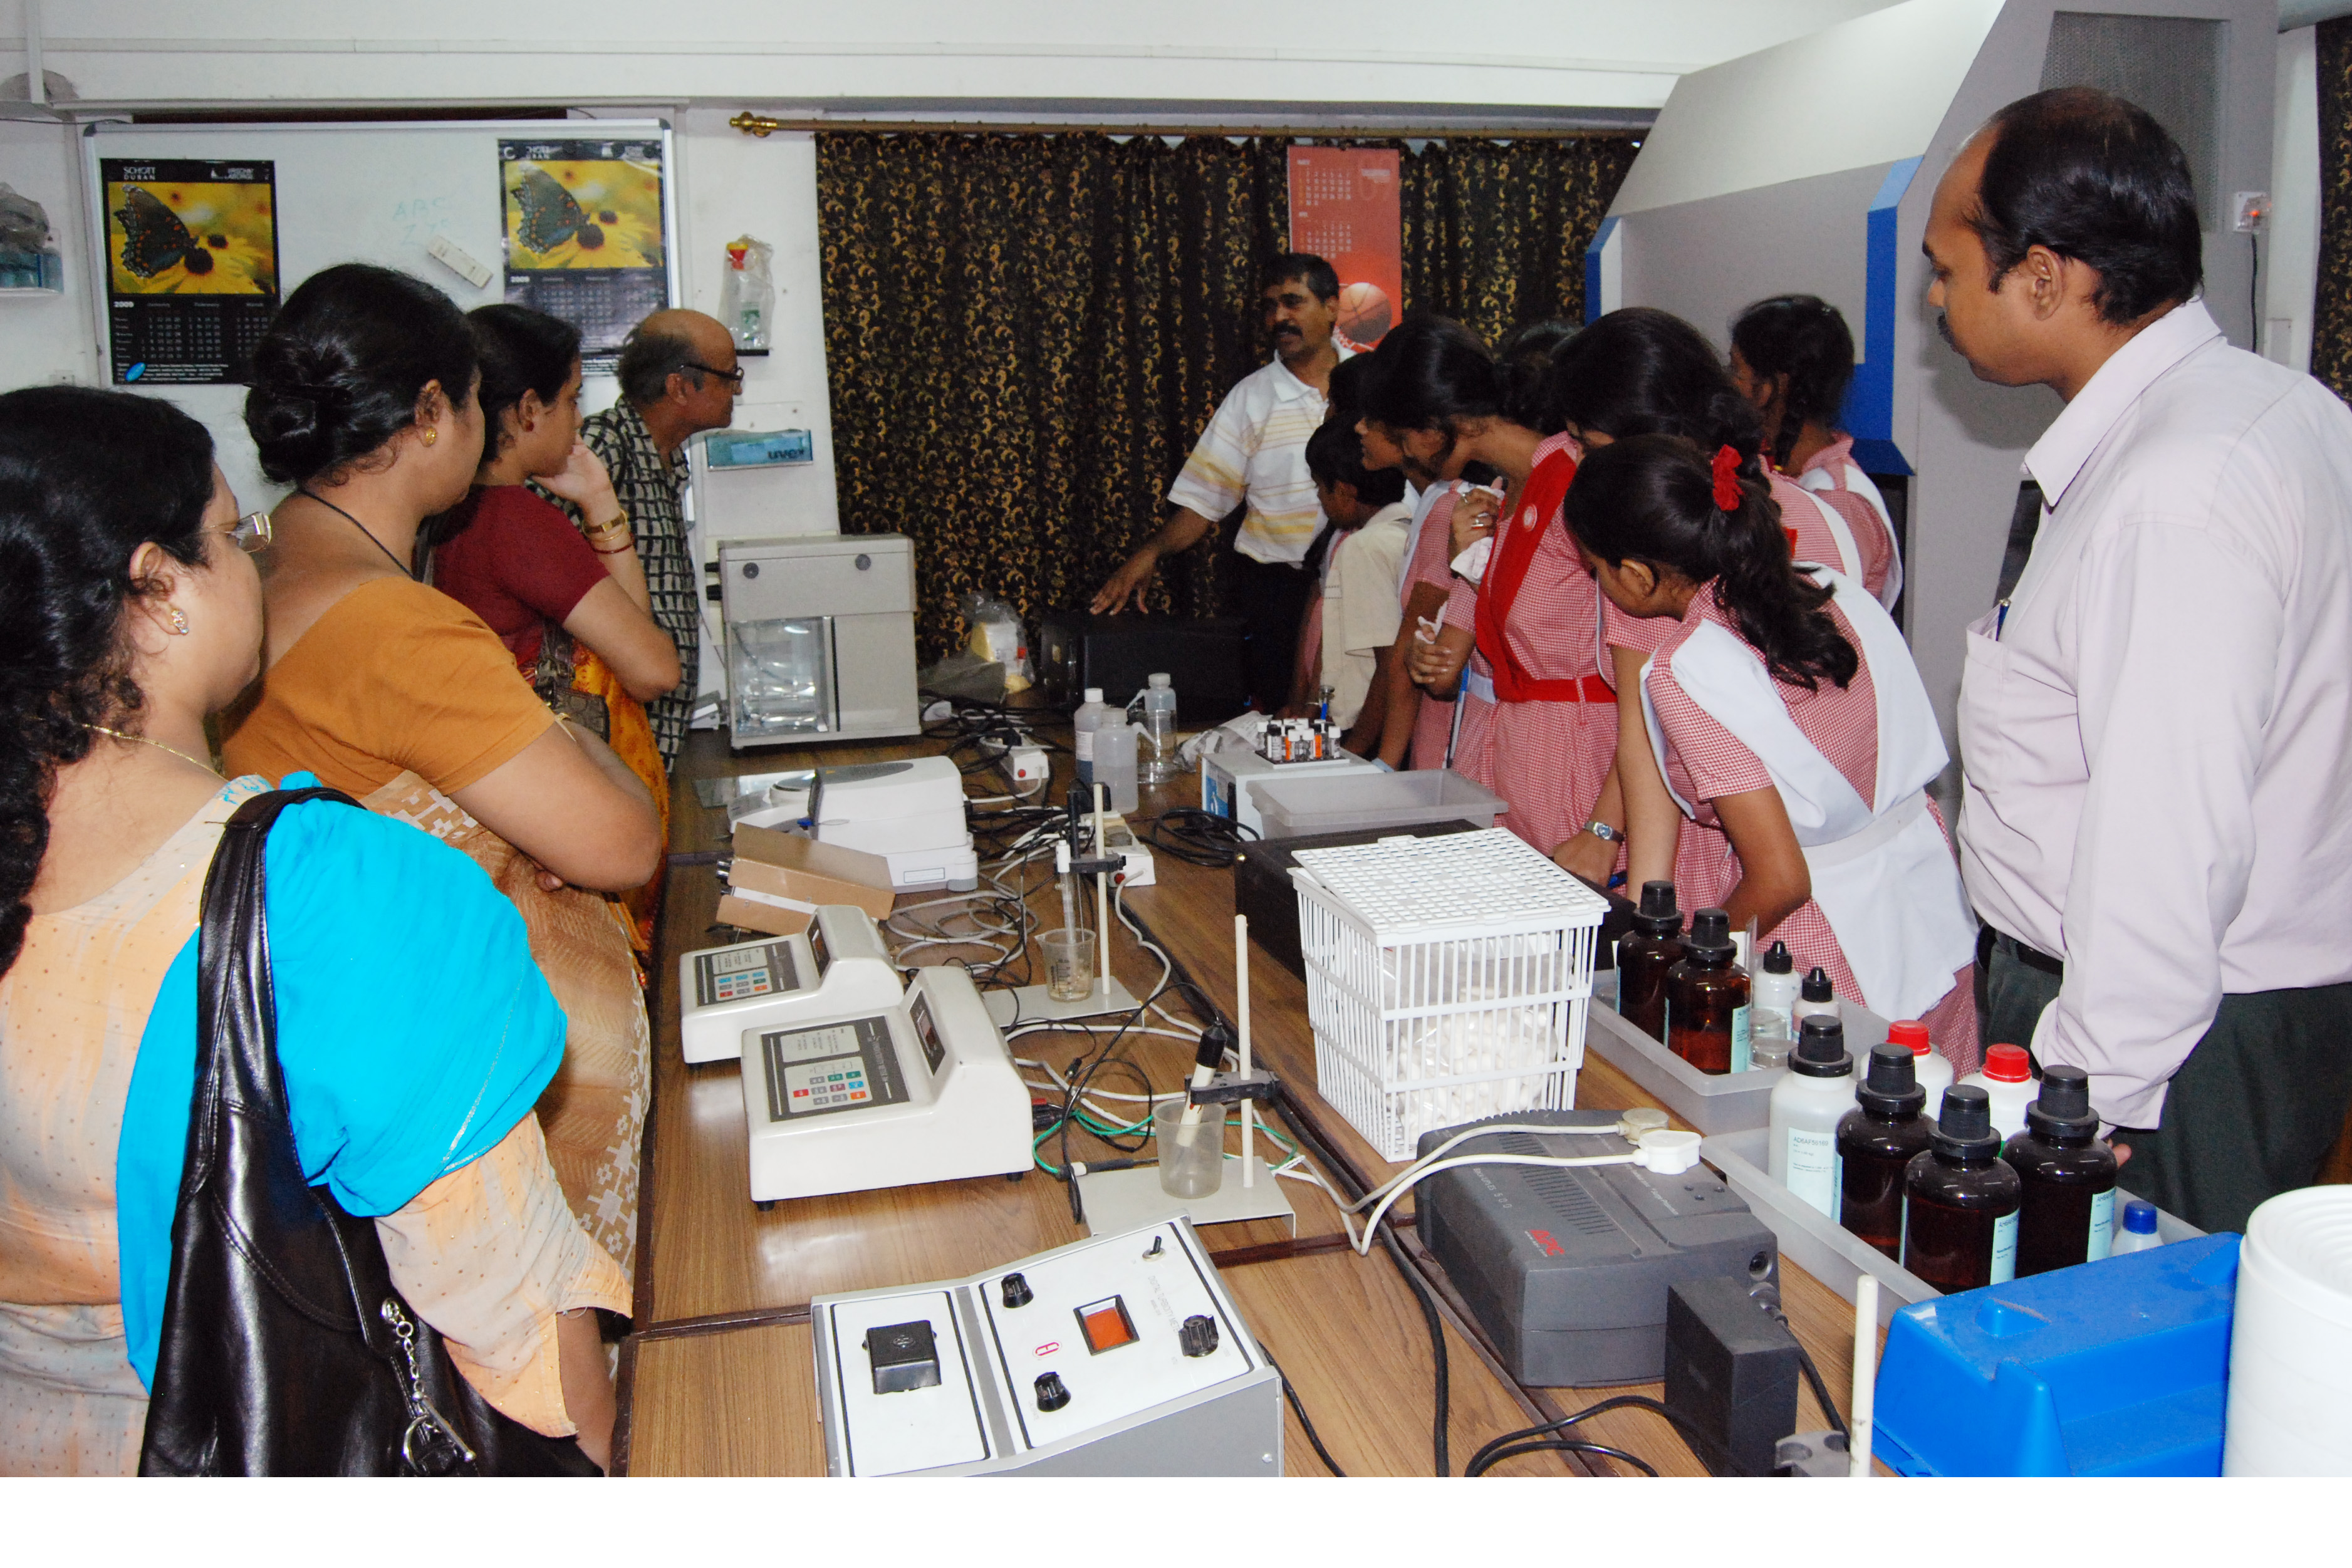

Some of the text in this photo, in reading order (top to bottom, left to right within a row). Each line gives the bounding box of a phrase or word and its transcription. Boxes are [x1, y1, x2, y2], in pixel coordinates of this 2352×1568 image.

[1494, 1193, 1512, 1208] 500
[1530, 1230, 1564, 1256] APC
[1148, 1275, 1161, 1294] DIGITAL
[1158, 1292, 1173, 1317] TURBIDITY
